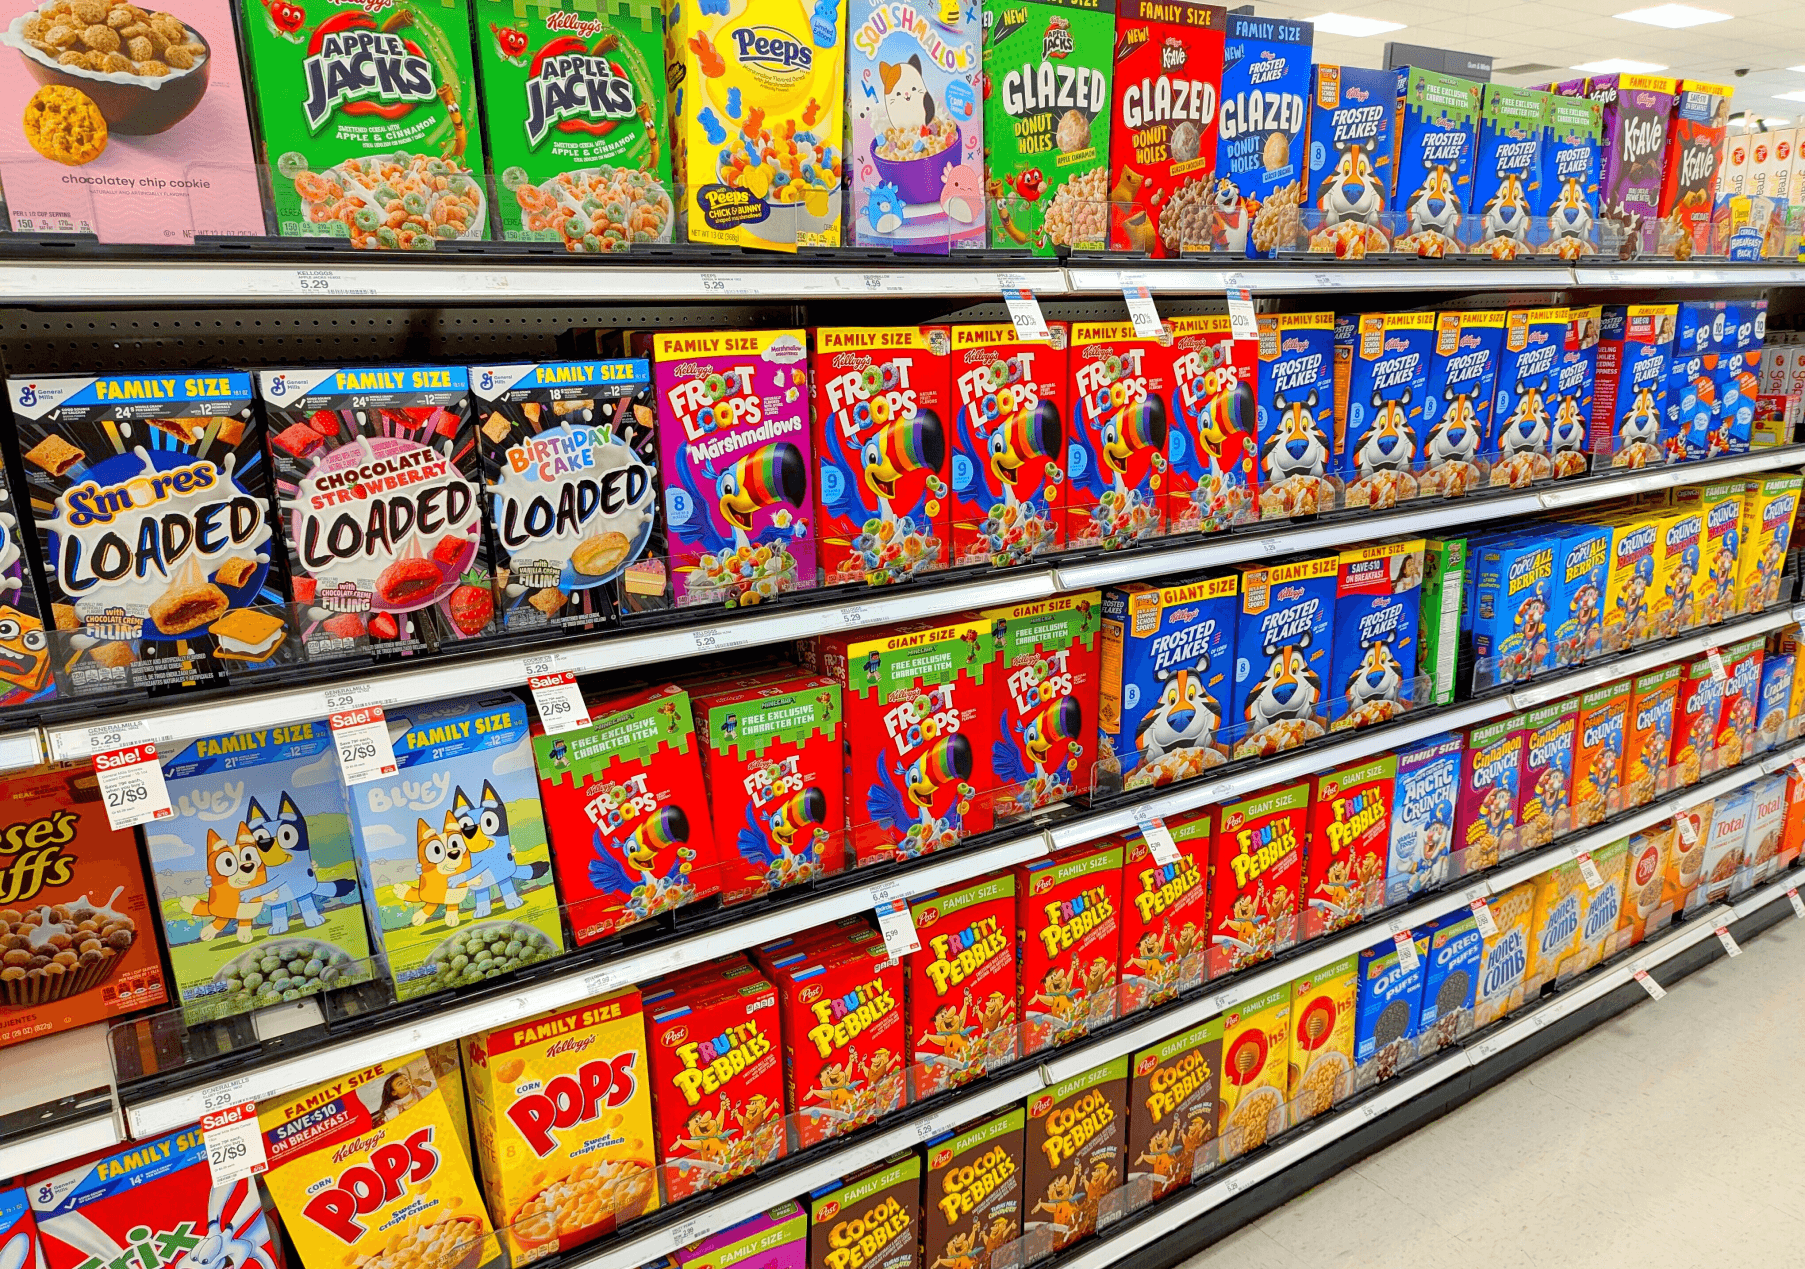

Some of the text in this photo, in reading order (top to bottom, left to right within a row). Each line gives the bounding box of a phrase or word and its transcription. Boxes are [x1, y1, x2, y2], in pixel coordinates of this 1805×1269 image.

[546, 11, 602, 36] Kellogg's
[1002, 9, 1028, 25] NEW!
[1140, 3, 1212, 26] FAMILY SIZE
[856, 7, 975, 72] SQUISHMALLOWS
[1127, 27, 1149, 44] NEW!
[1236, 21, 1300, 40] FAMILY SIZE
[323, 31, 403, 57] APPLE
[731, 28, 813, 67] Peeps
[1225, 43, 1244, 61] NEW!
[542, 56, 610, 81] APPLE
[1249, 58, 1286, 75] FROSTED
[1250, 69, 1282, 84] FLAKES
[304, 53, 436, 124] JACKS
[1002, 61, 1106, 117] GLAZED
[1629, 77, 1667, 90] FAMILY SIZE
[526, 76, 635, 146] JACKS
[1122, 77, 1215, 127] GLAZED
[1219, 89, 1304, 140] GLAZED
[1331, 105, 1383, 126] FROSTED
[1014, 114, 1052, 138] DONUT
[1333, 120, 1379, 141] FLAKES
[551, 147, 580, 157] APPLE
[593, 133, 635, 155] CINNAMON
[1018, 134, 1052, 154] HOLES
[62, 173, 211, 190] chocolatey chip cookie
[708, 207, 731, 219] CHICK
[737, 203, 762, 216] BUNNY
[1732, 236, 1763, 250] BREAKFAST
[1737, 249, 1752, 259] PACK
[300, 279, 329, 290] 5.29
[704, 281, 725, 290] 5.29
[866, 279, 881, 287] 4.59
[1463, 313, 1504, 323] FAMILY SIZE
[832, 353, 872, 369] Kellogg's
[1272, 354, 1322, 378] FROSTED
[1633, 355, 1663, 373] FROSTED
[95, 377, 232, 400] FAMILY SIZE
[337, 371, 451, 390] FAMILY SIZE
[825, 357, 913, 413] FROOT
[1275, 371, 1317, 391] FLAKES
[668, 366, 755, 418] FROOT
[681, 396, 761, 441] LOOPS
[840, 389, 918, 438] LOOPS
[690, 415, 802, 465] Marshmallows
[315, 449, 435, 491] CHOCOLATE
[539, 449, 594, 482] CAKE
[67, 462, 217, 526] S'mres
[310, 461, 448, 511] STRWBERRY
[1705, 483, 1746, 497] FAMILY SIZE
[503, 465, 647, 549] LOADED
[304, 481, 471, 567] LOADED
[65, 496, 261, 593] LOADED
[1617, 527, 1656, 557] CRUNCH
[1533, 549, 1552, 569] ALL
[1272, 560, 1337, 582] GIANT SIZE
[1346, 570, 1384, 584] ON BREAKFAST
[1508, 564, 1552, 596] BERRIES
[86, 615, 121, 623] CHOCOLATE
[843, 613, 861, 622] 5.29
[1135, 624, 1156, 632] SPORTS
[1136, 618, 1157, 627] SCHOOL
[86, 623, 143, 641] FILLING
[696, 637, 716, 648] 5.29
[1151, 619, 1215, 656] FROSTED
[891, 652, 952, 671] FREE EXCLUSIVE
[1154, 641, 1209, 671] FLAKES
[526, 664, 549, 674] 5.29
[891, 660, 952, 680] CHARACTER ITEM
[530, 675, 564, 688] Sale!
[327, 695, 354, 708] 5.29
[541, 701, 571, 716] 2/$9
[332, 710, 370, 728] Sale!
[1474, 715, 1525, 742] FAMILY SIZE
[91, 733, 121, 747] 5.29
[407, 722, 470, 750] FAMILY
[475, 712, 512, 734] SIZE
[97, 749, 141, 770] Sale!
[342, 745, 376, 762] 2/$9
[1473, 736, 1521, 770] Cinnamon
[1473, 753, 1519, 789] CRUNCH
[108, 787, 148, 807] 2/$9
[367, 771, 451, 813] BLUEY
[1249, 794, 1292, 816] GIANT SIZE
[1403, 786, 1450, 823] CRUNCH
[1716, 822, 1745, 838] Total
[1058, 856, 1108, 879] FAMILY SIZE
[1034, 877, 1053, 892] Post
[872, 891, 889, 902] 6.49
[1039, 899, 1113, 959] PEBBLES
[1437, 932, 1479, 967] OREO
[1449, 945, 1479, 969] PUFFS
[513, 1003, 622, 1046] FAMILY SIZE
[664, 1028, 685, 1043] Post
[516, 1082, 540, 1094] CORN
[1057, 1069, 1108, 1097] GIANT SIZE
[204, 1093, 231, 1109] 5.29
[506, 1051, 638, 1158] POPS
[1030, 1096, 1053, 1117] Post
[203, 1108, 242, 1130] Sale!
[1046, 1089, 1105, 1137] COCOA
[271, 1110, 350, 1154] ON BREAKFAST
[956, 1120, 1008, 1150] FAMILY SIZE
[1041, 1104, 1115, 1169] PEBBLES
[97, 1129, 204, 1181] FAMILY SIZ
[212, 1143, 247, 1165] 2/$9
[302, 1128, 439, 1244] POPS
[306, 1177, 332, 1194] CORN
